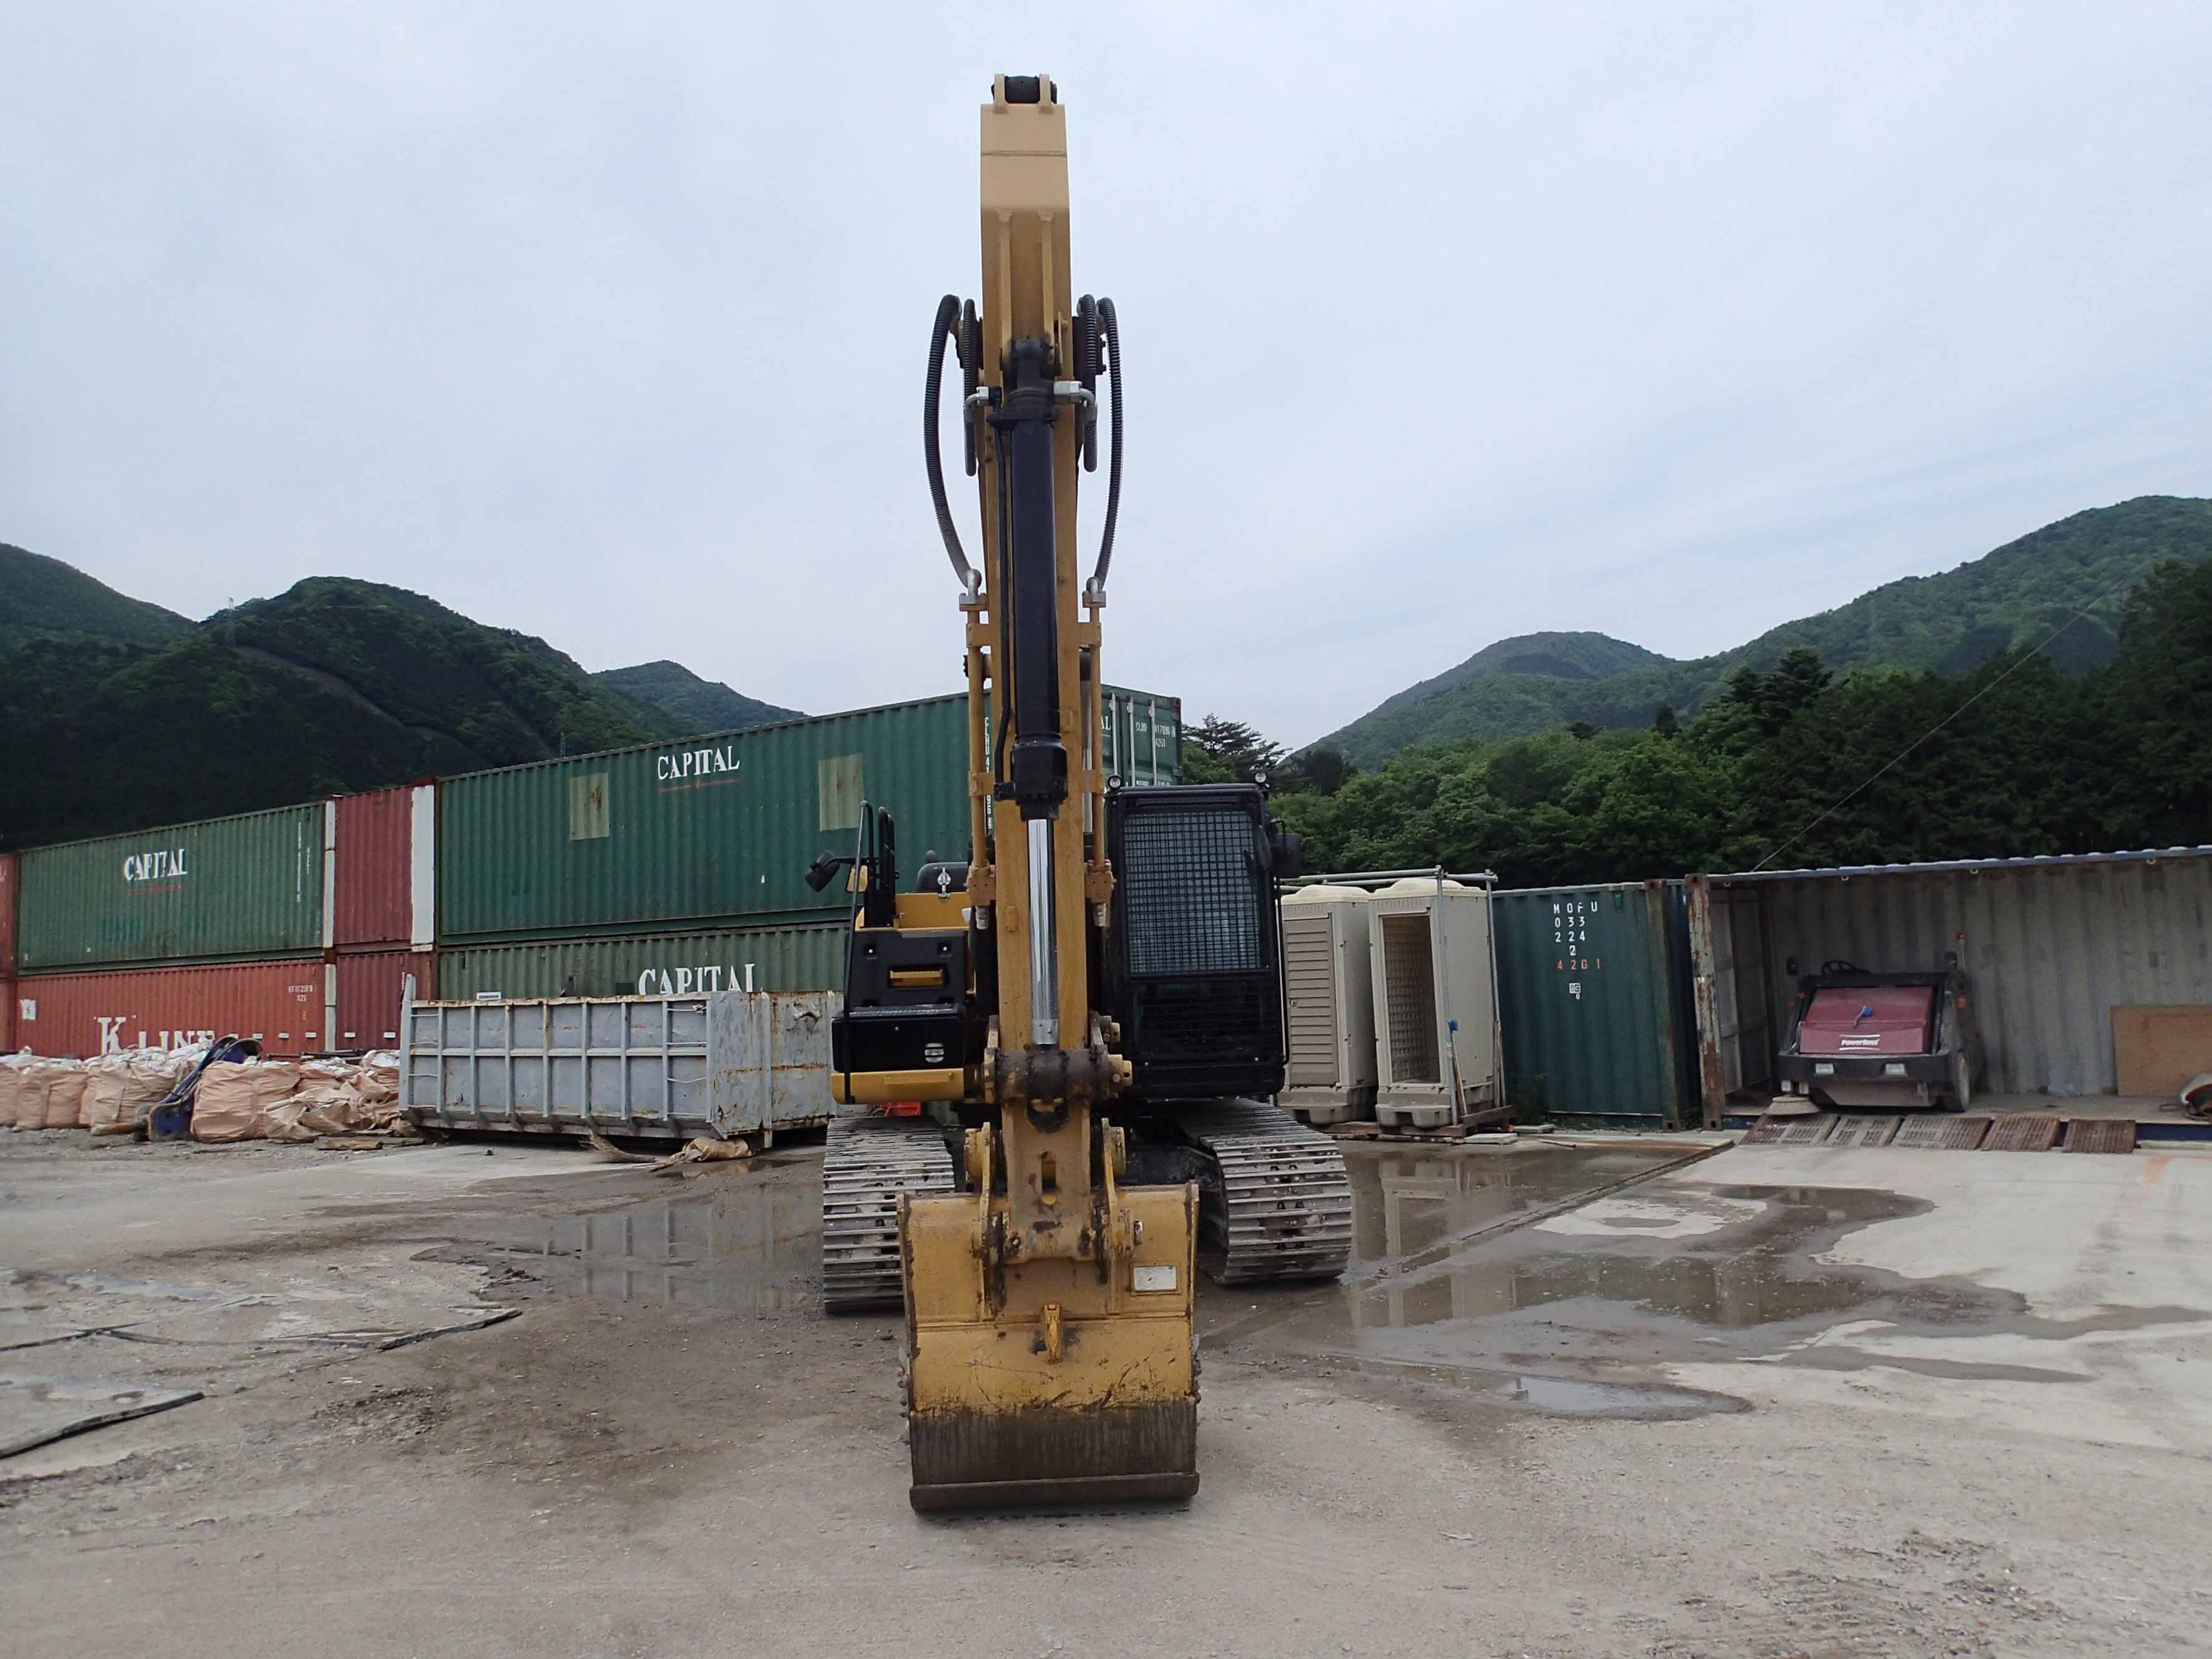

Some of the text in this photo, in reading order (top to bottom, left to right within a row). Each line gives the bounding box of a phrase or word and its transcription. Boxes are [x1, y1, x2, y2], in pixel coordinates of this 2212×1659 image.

[657, 746, 740, 780] CAPITAL
[124, 849, 188, 881] CAPITAL
[1553, 901, 1598, 914] MOFU
[1555, 916, 1585, 928] 033
[1555, 930, 1586, 942] 224
[1569, 945, 1576, 956] 2
[639, 963, 763, 995] CAPITAL
